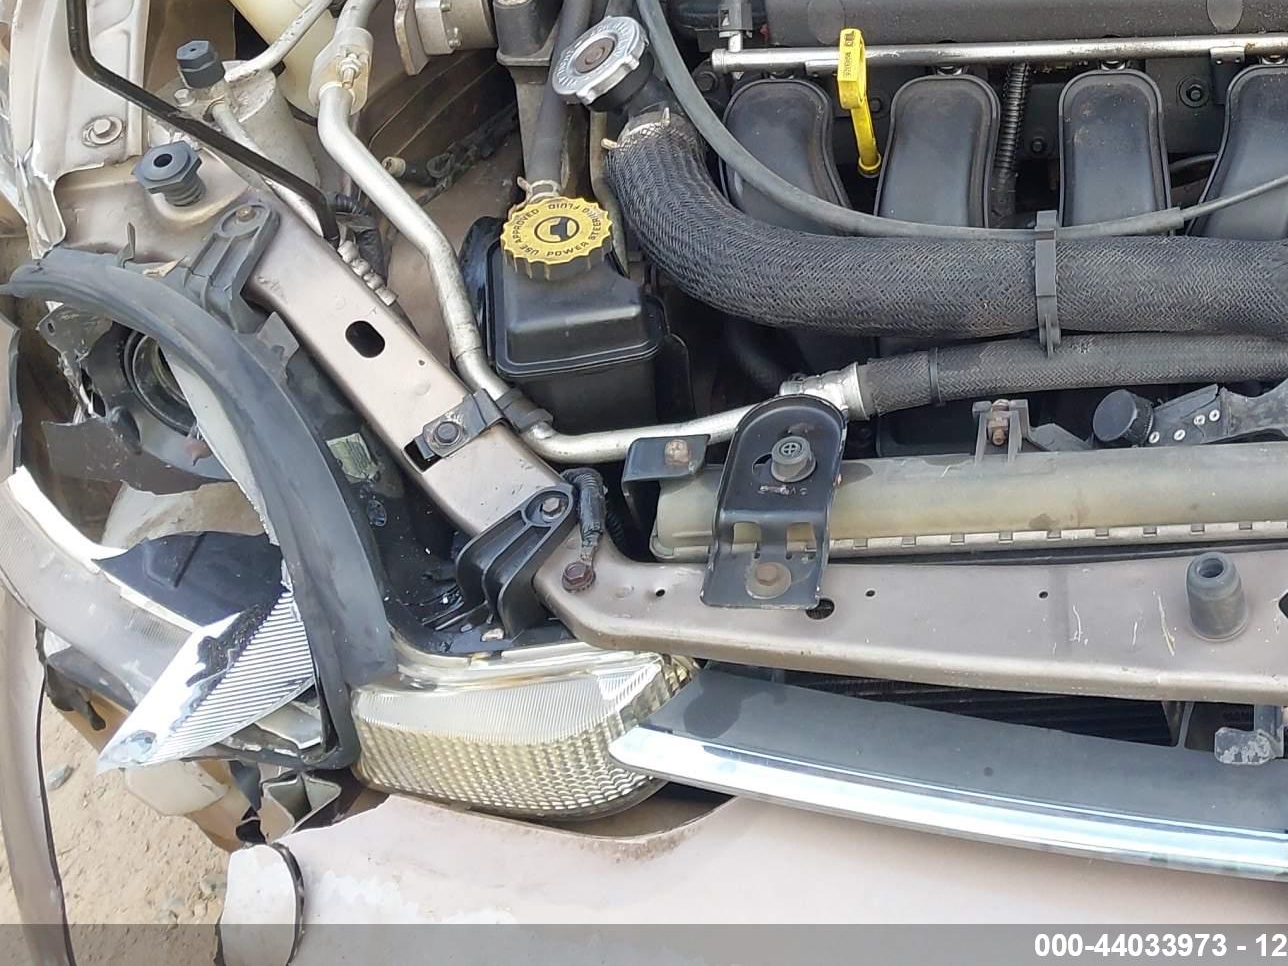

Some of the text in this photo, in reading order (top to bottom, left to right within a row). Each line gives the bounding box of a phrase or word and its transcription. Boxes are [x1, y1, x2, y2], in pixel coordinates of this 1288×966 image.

[548, 202, 581, 210] FLUID
[512, 208, 540, 256] USE APPROVED
[546, 241, 589, 257] POWER
